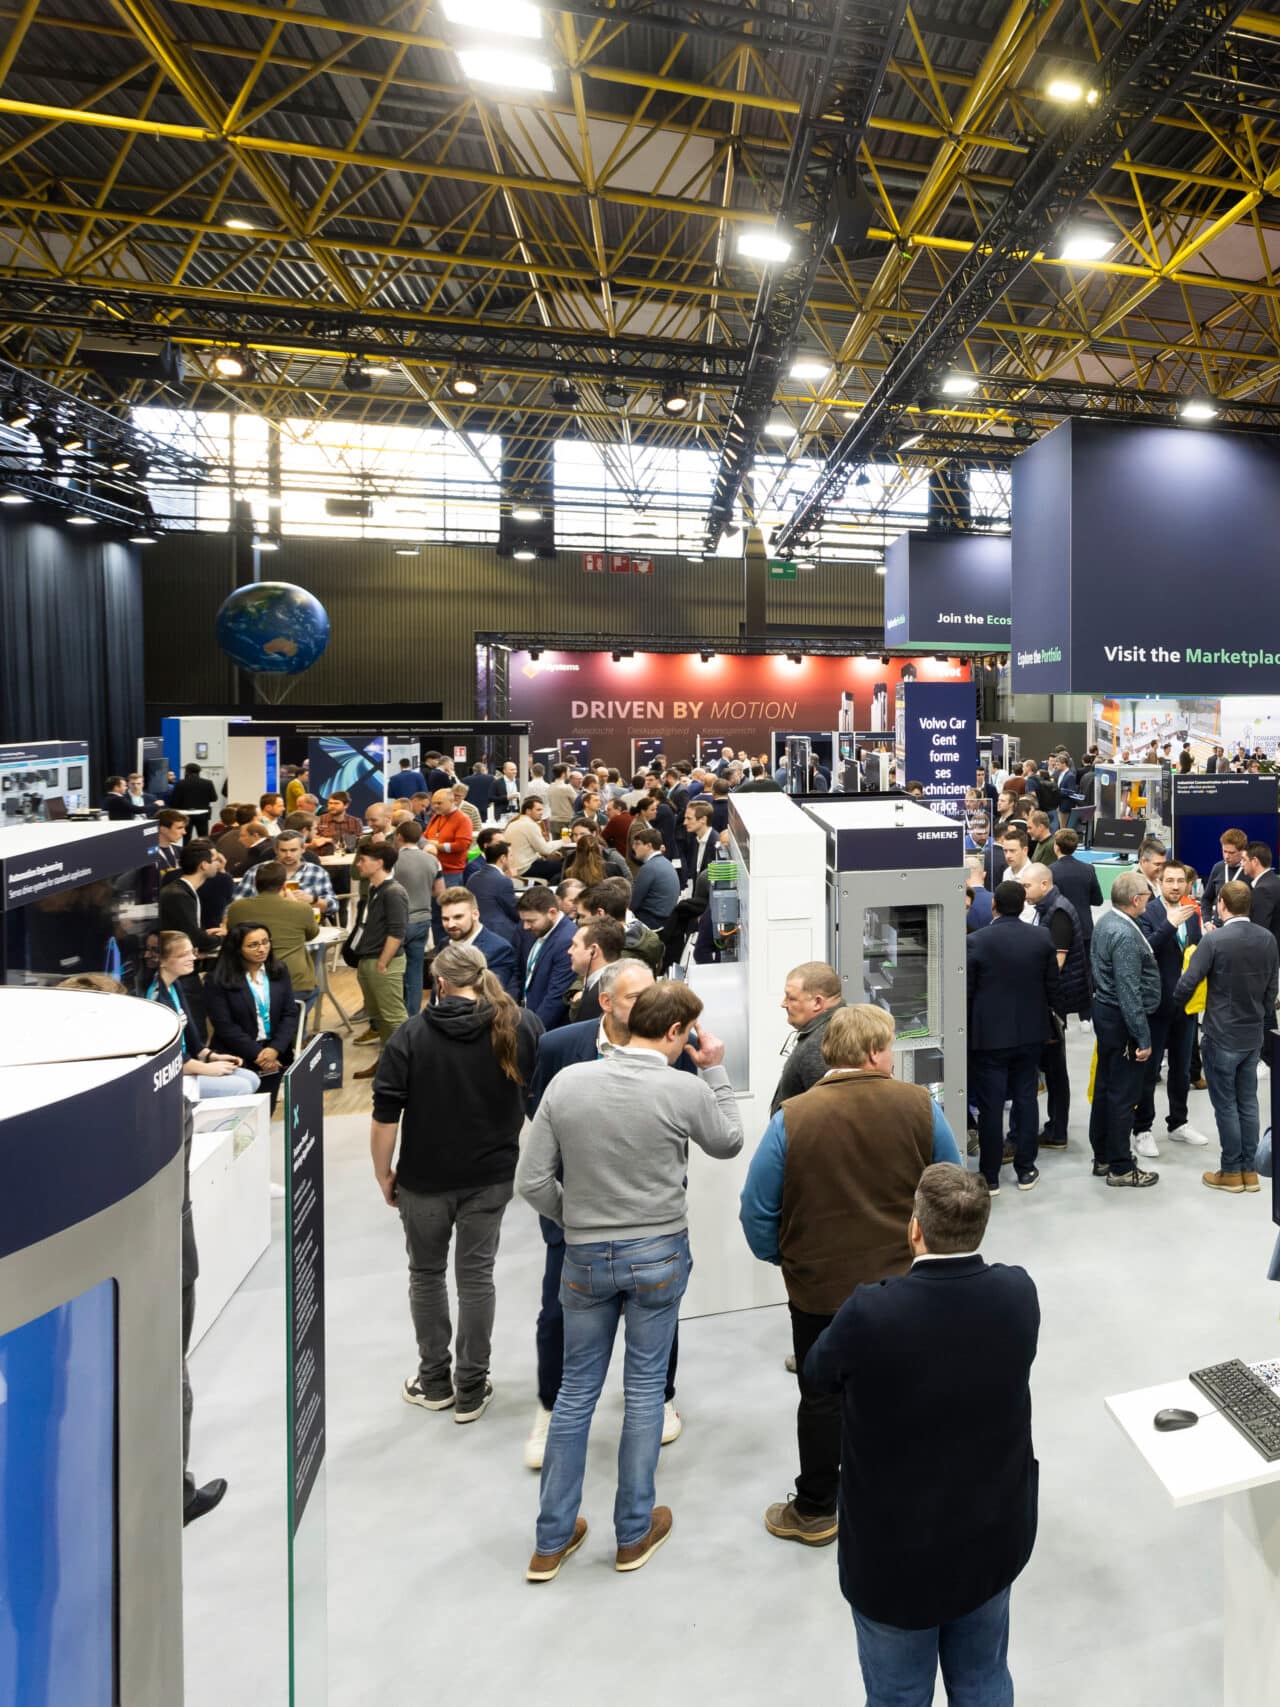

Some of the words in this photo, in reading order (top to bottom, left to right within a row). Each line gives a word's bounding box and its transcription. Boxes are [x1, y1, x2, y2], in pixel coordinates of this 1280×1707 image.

[937, 613, 962, 624] Join
[964, 613, 984, 625] the
[1018, 652, 1034, 668] Explore
[1033, 651, 1041, 664] the
[1041, 646, 1062, 664] Portfolio
[1104, 645, 1147, 663] Visit
[1150, 647, 1181, 663] the
[571, 701, 665, 719] DRIVEN
[673, 701, 704, 719] BY
[709, 702, 798, 720] MOTION
[919, 717, 947, 729] Volvo
[949, 717, 967, 729] Car
[932, 734, 957, 746] Gent
[929, 750, 960, 762] forme
[935, 768, 952, 779] ses
[917, 831, 958, 840] SIEMENS
